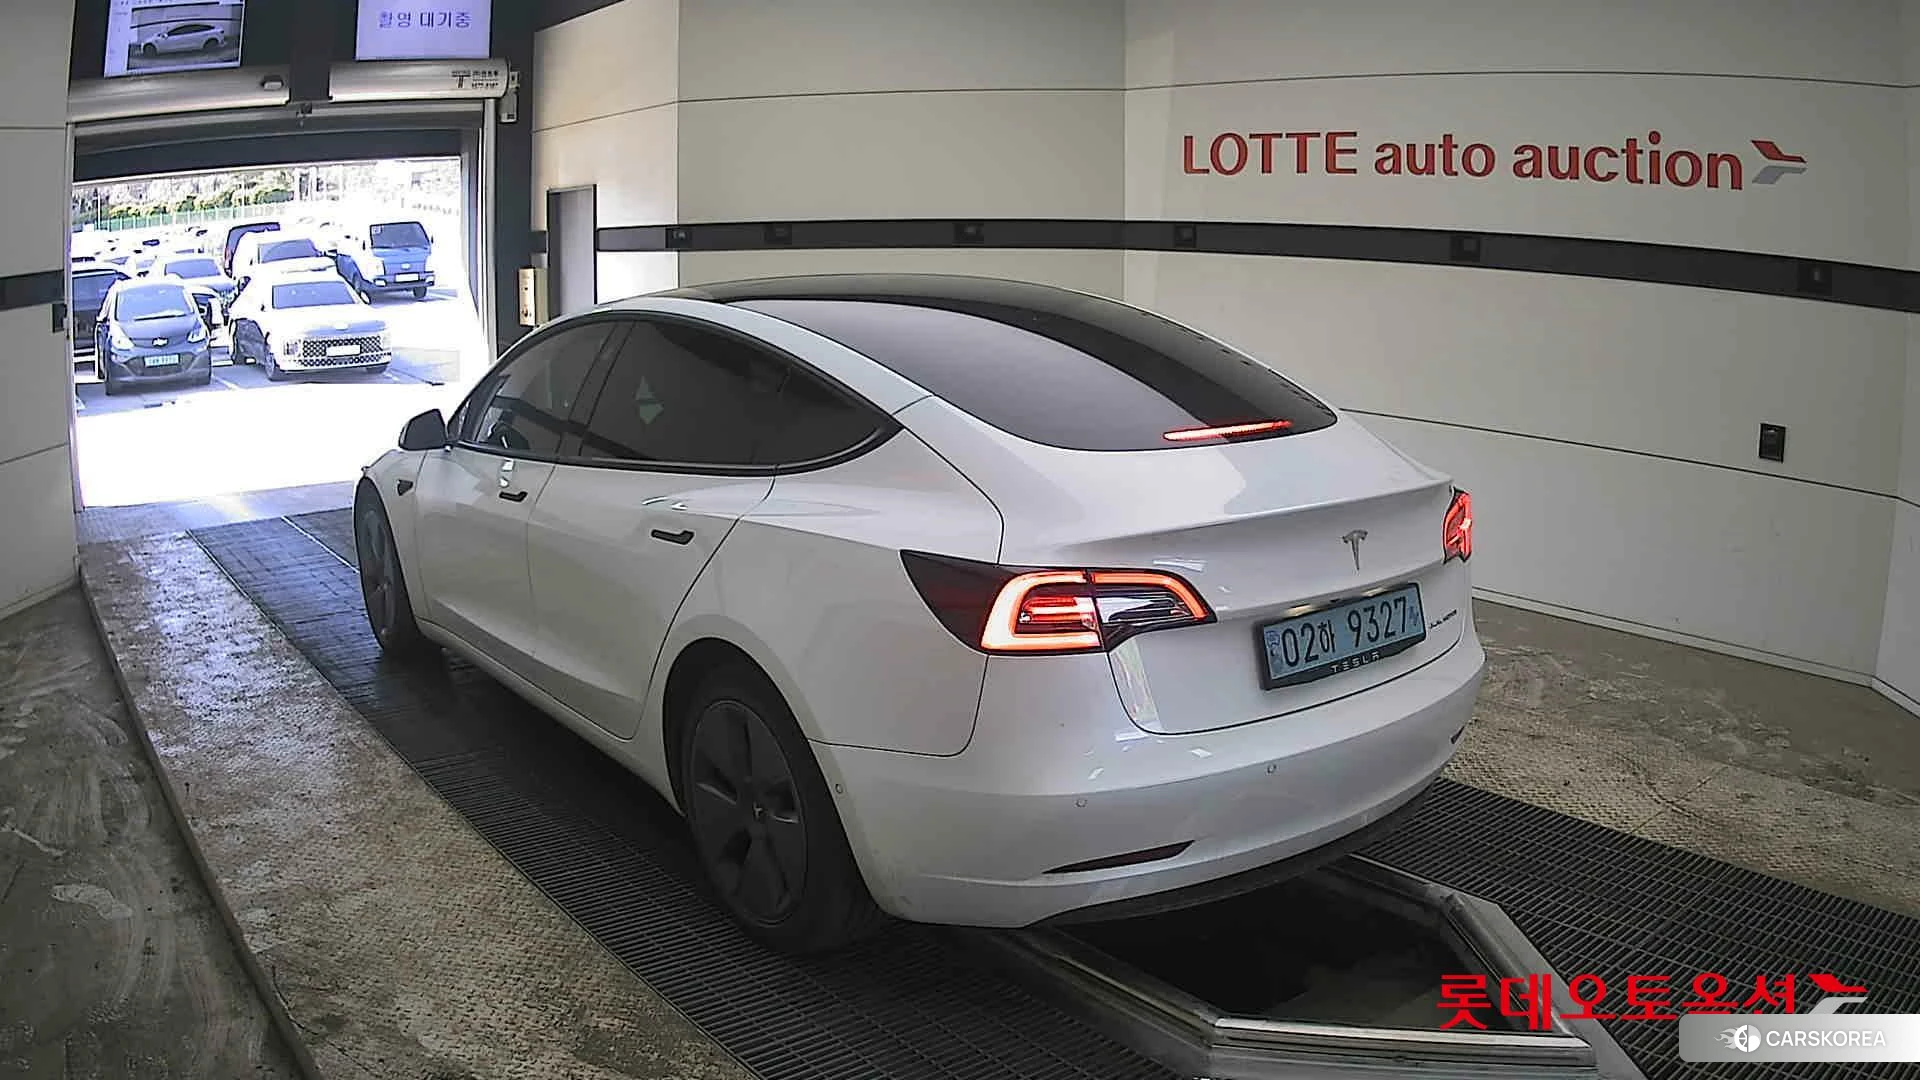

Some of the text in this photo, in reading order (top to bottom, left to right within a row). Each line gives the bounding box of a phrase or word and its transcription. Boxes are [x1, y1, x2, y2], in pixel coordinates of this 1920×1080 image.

[420, 11, 472, 29] 대기중
[1184, 130, 1743, 189] LOTTE auto auction
[1281, 596, 1407, 668] 02하 9327
[1331, 651, 1379, 673] TESLA
